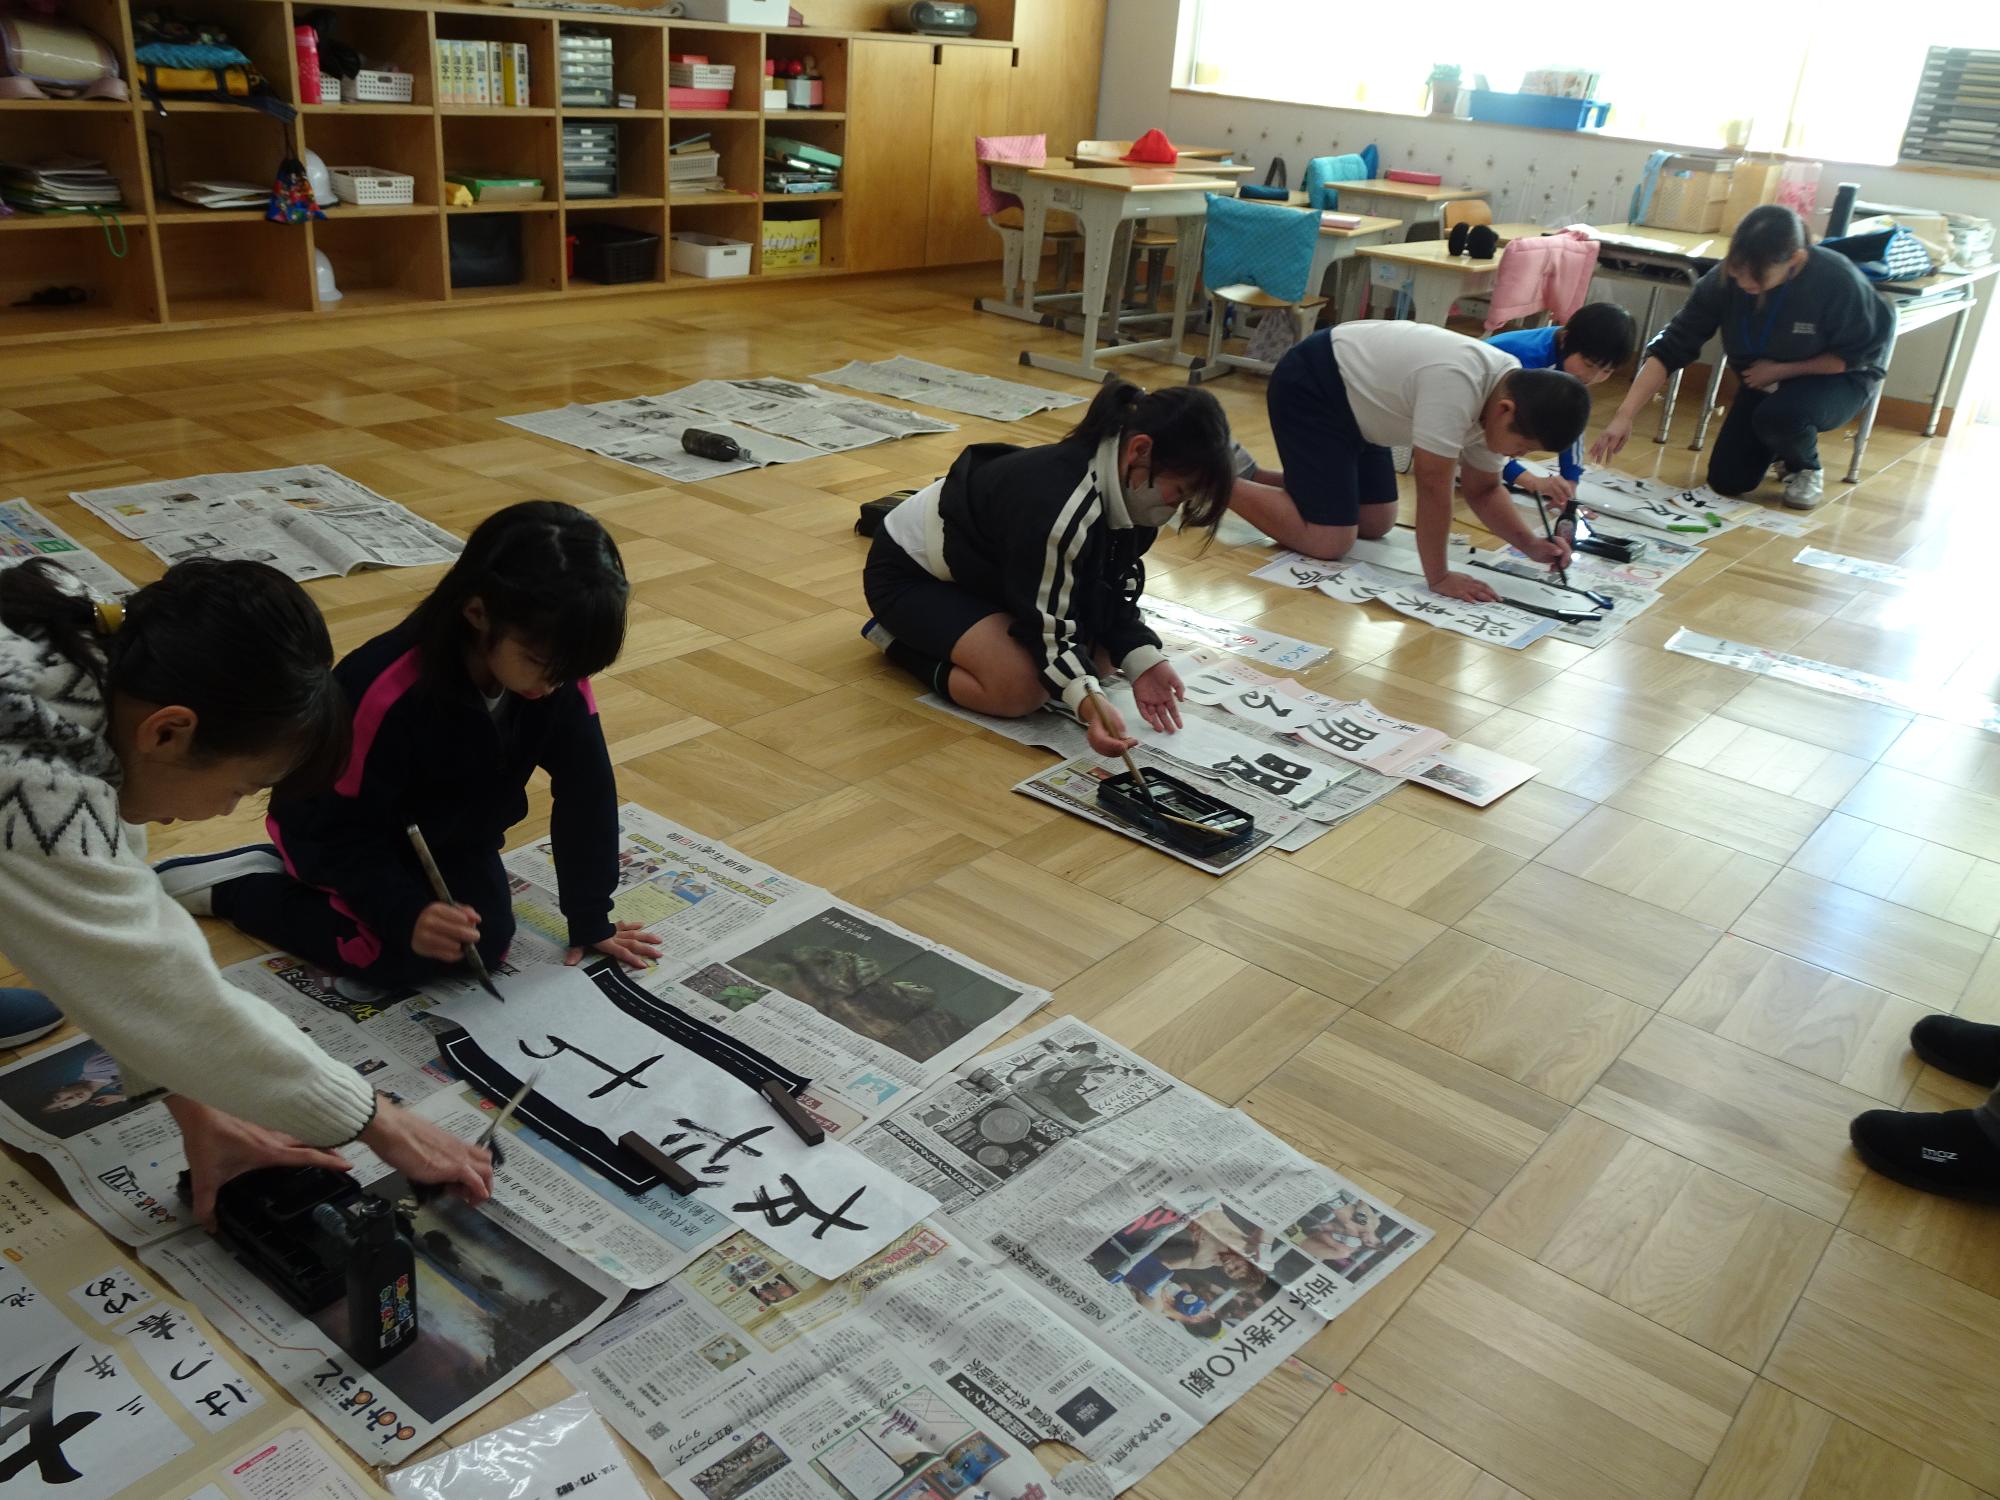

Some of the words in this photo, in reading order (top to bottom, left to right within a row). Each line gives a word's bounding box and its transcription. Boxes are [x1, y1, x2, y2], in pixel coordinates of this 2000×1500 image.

[666, 830, 753, 876] 朝日小学生新聞
[1045, 1273, 1107, 1322] 2回から攻め
[1285, 1272, 1338, 1312] 尚弥
[1178, 1304, 1296, 1400] 圧巻KO劇
[314, 1357, 416, 1443] よみほっと
[963, 1358, 1031, 1412] 先行抽選販売
[667, 1427, 702, 1454] タップリ
[674, 1423, 734, 1466] 役立つニュース
